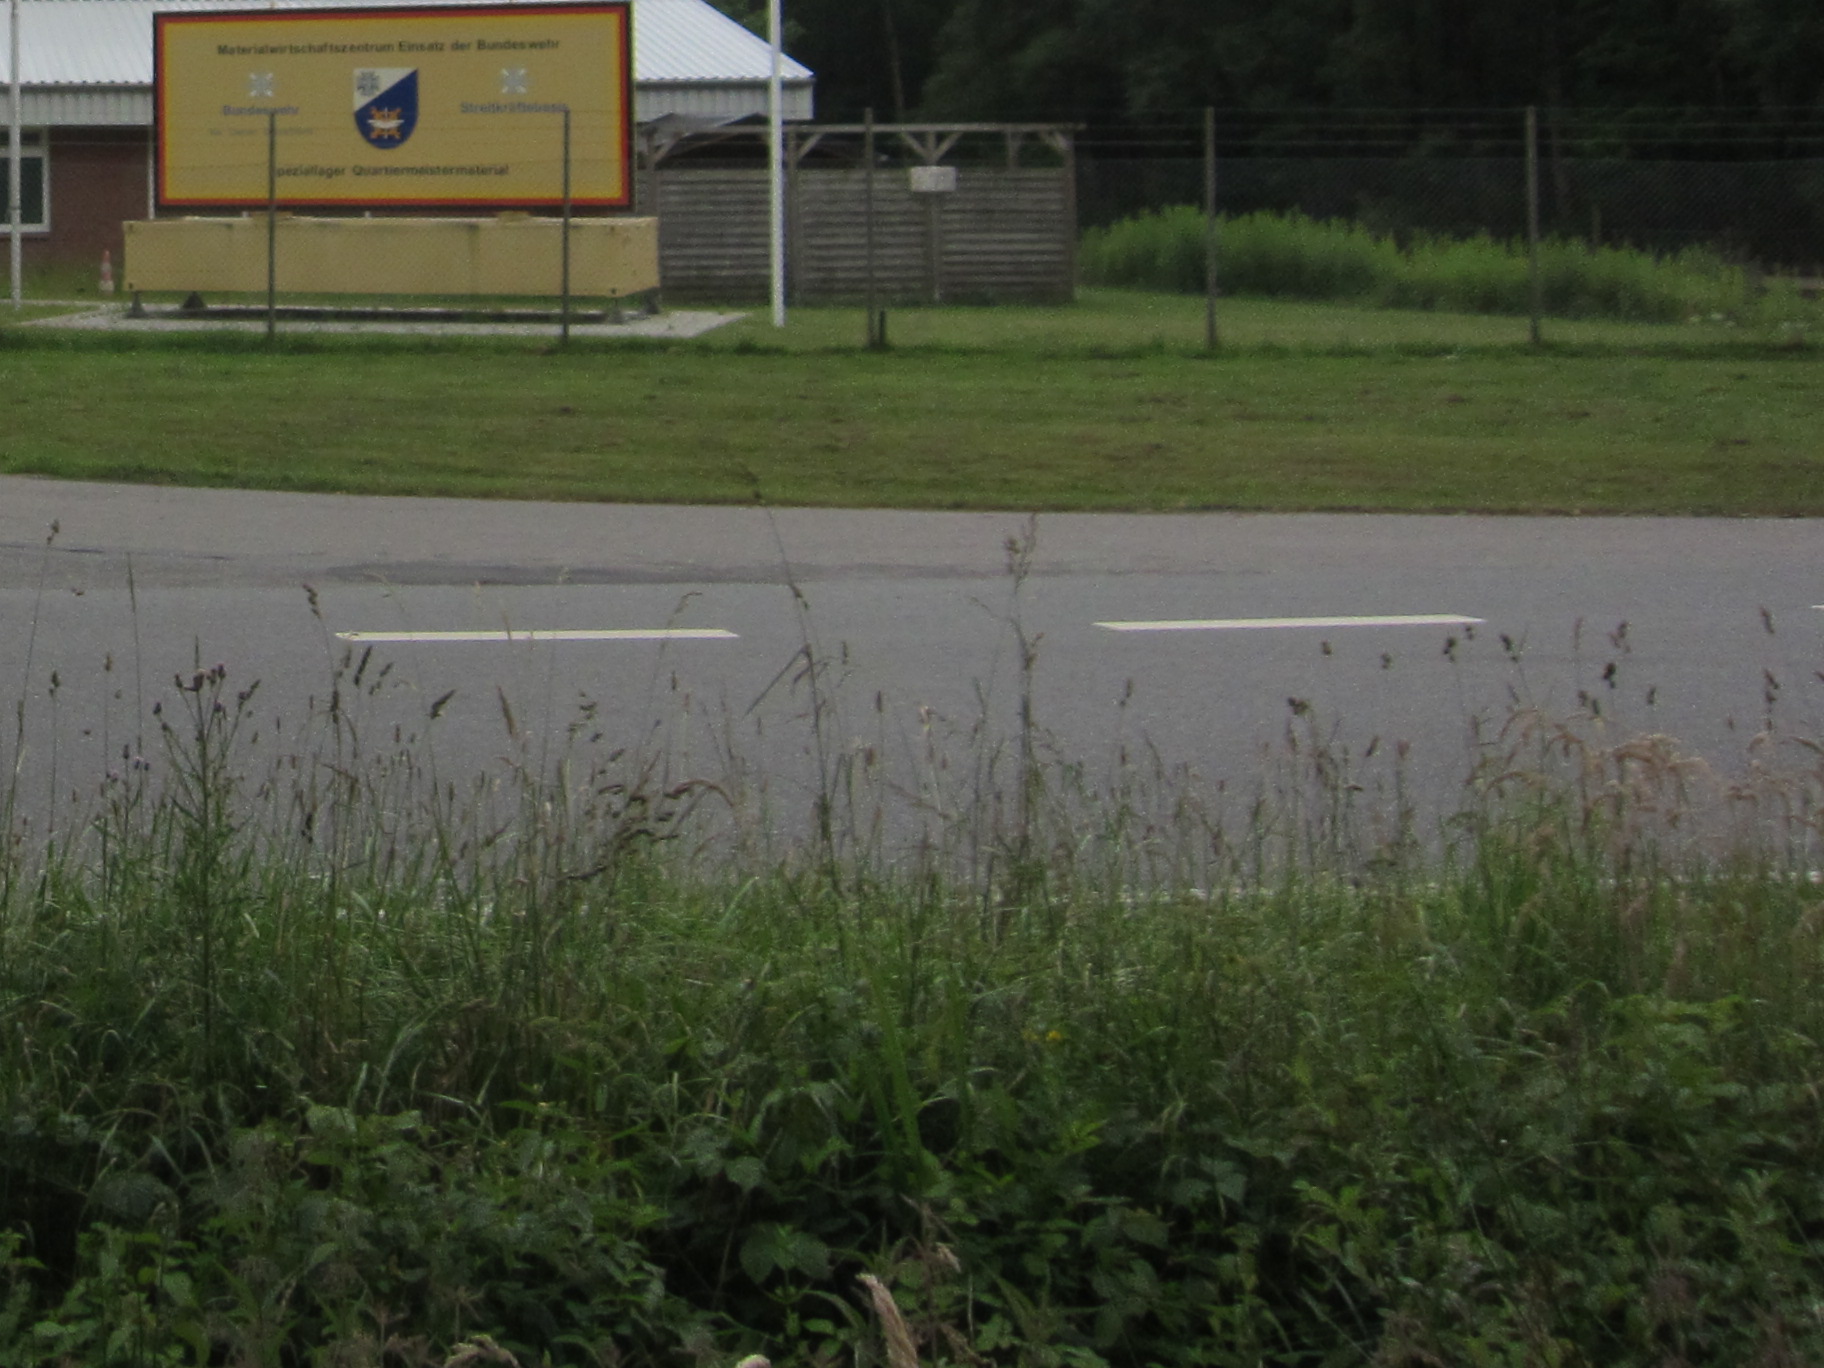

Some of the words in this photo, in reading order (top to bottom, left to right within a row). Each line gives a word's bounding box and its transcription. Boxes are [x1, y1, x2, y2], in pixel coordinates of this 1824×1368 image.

[217, 42, 394, 55] Materialwirtschaftszentrum
[398, 40, 444, 52] Einsatz
[450, 40, 472, 51] der
[476, 39, 560, 51] Bundeswehr
[222, 105, 300, 116] Bundeswehr
[272, 165, 345, 178] peziallager
[351, 164, 509, 177] Quartiermeistermaterial
